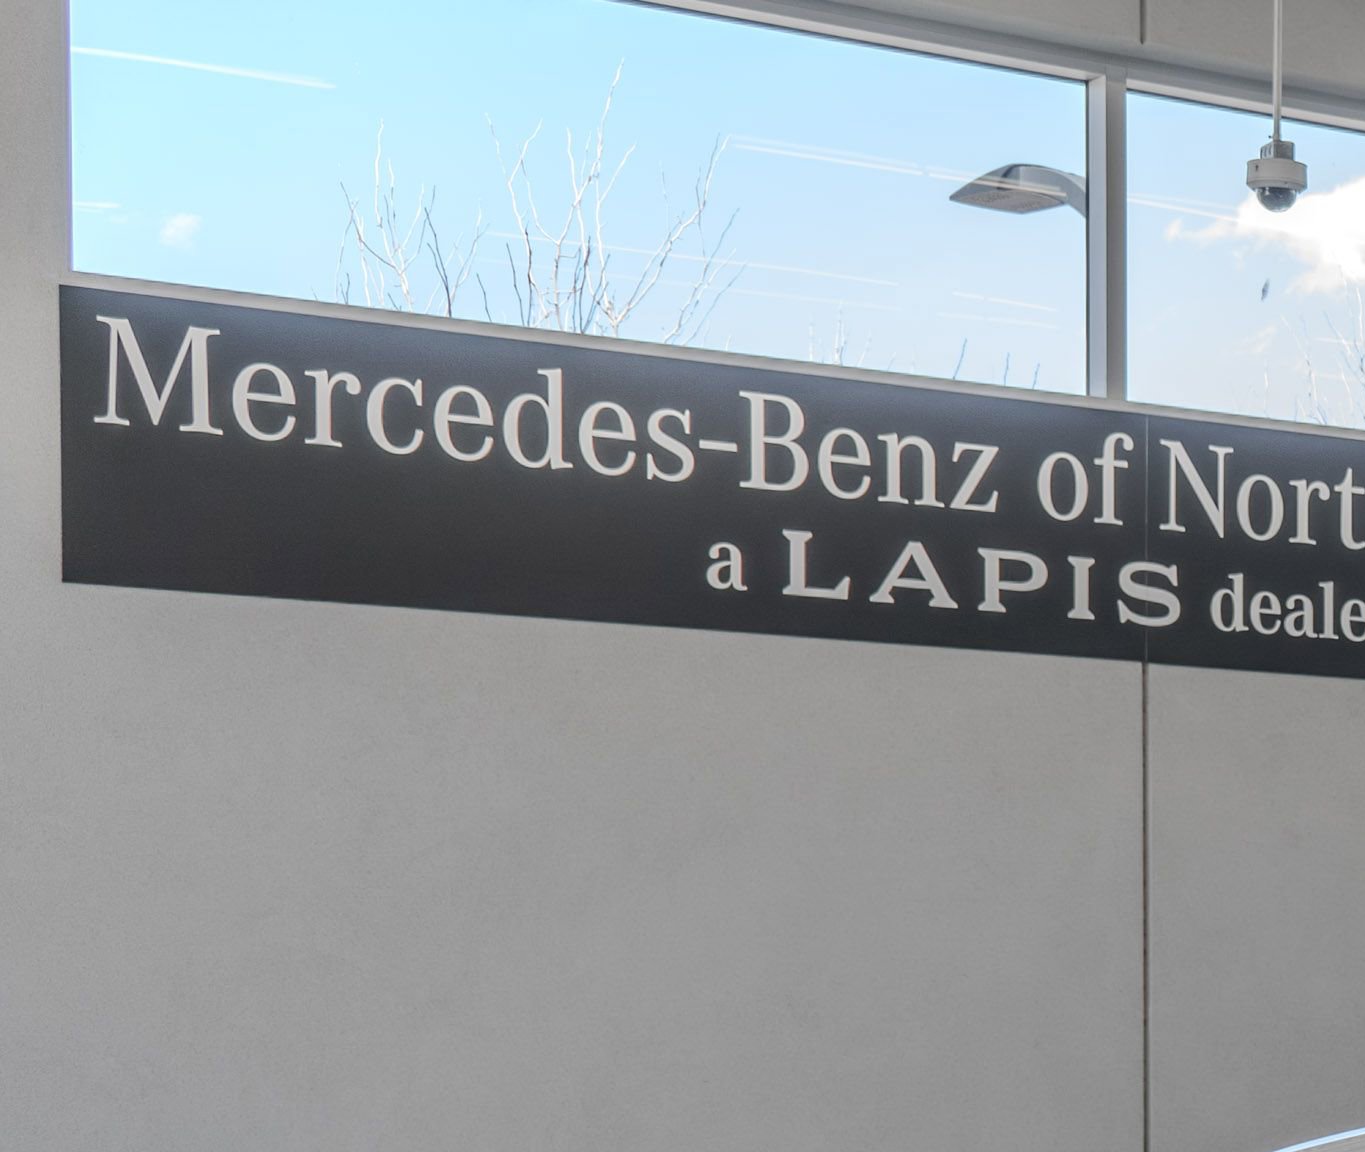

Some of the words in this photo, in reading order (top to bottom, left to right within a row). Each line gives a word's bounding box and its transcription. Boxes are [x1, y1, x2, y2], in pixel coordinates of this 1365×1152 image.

[94, 314, 1000, 513] Mercedes-Benz
[1037, 431, 1135, 526] of
[706, 542, 749, 591] a
[782, 528, 1181, 627] LAPIS
